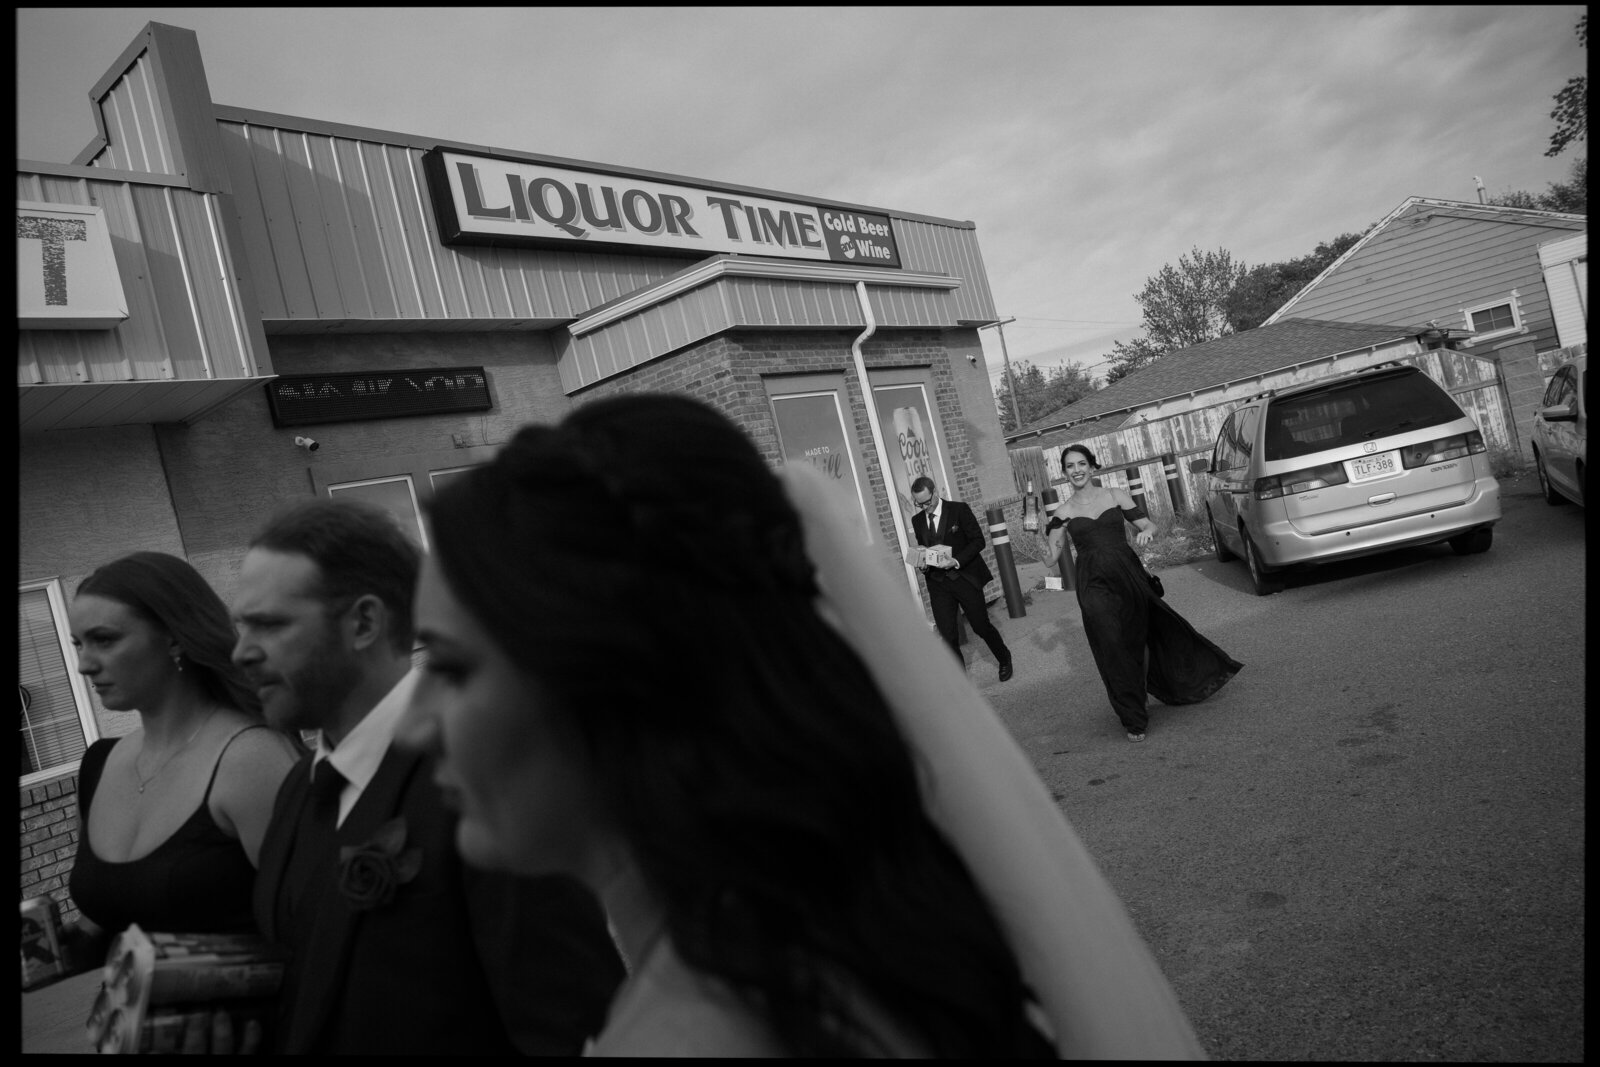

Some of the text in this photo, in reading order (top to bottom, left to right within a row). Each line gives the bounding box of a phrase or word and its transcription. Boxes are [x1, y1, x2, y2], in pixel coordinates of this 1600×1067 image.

[455, 161, 824, 250] LIQUOR TIME
[823, 212, 889, 237] Cold Beer
[855, 239, 891, 260] Wine
[804, 446, 830, 457] MADE TO
[904, 457, 932, 477] LIGHT
